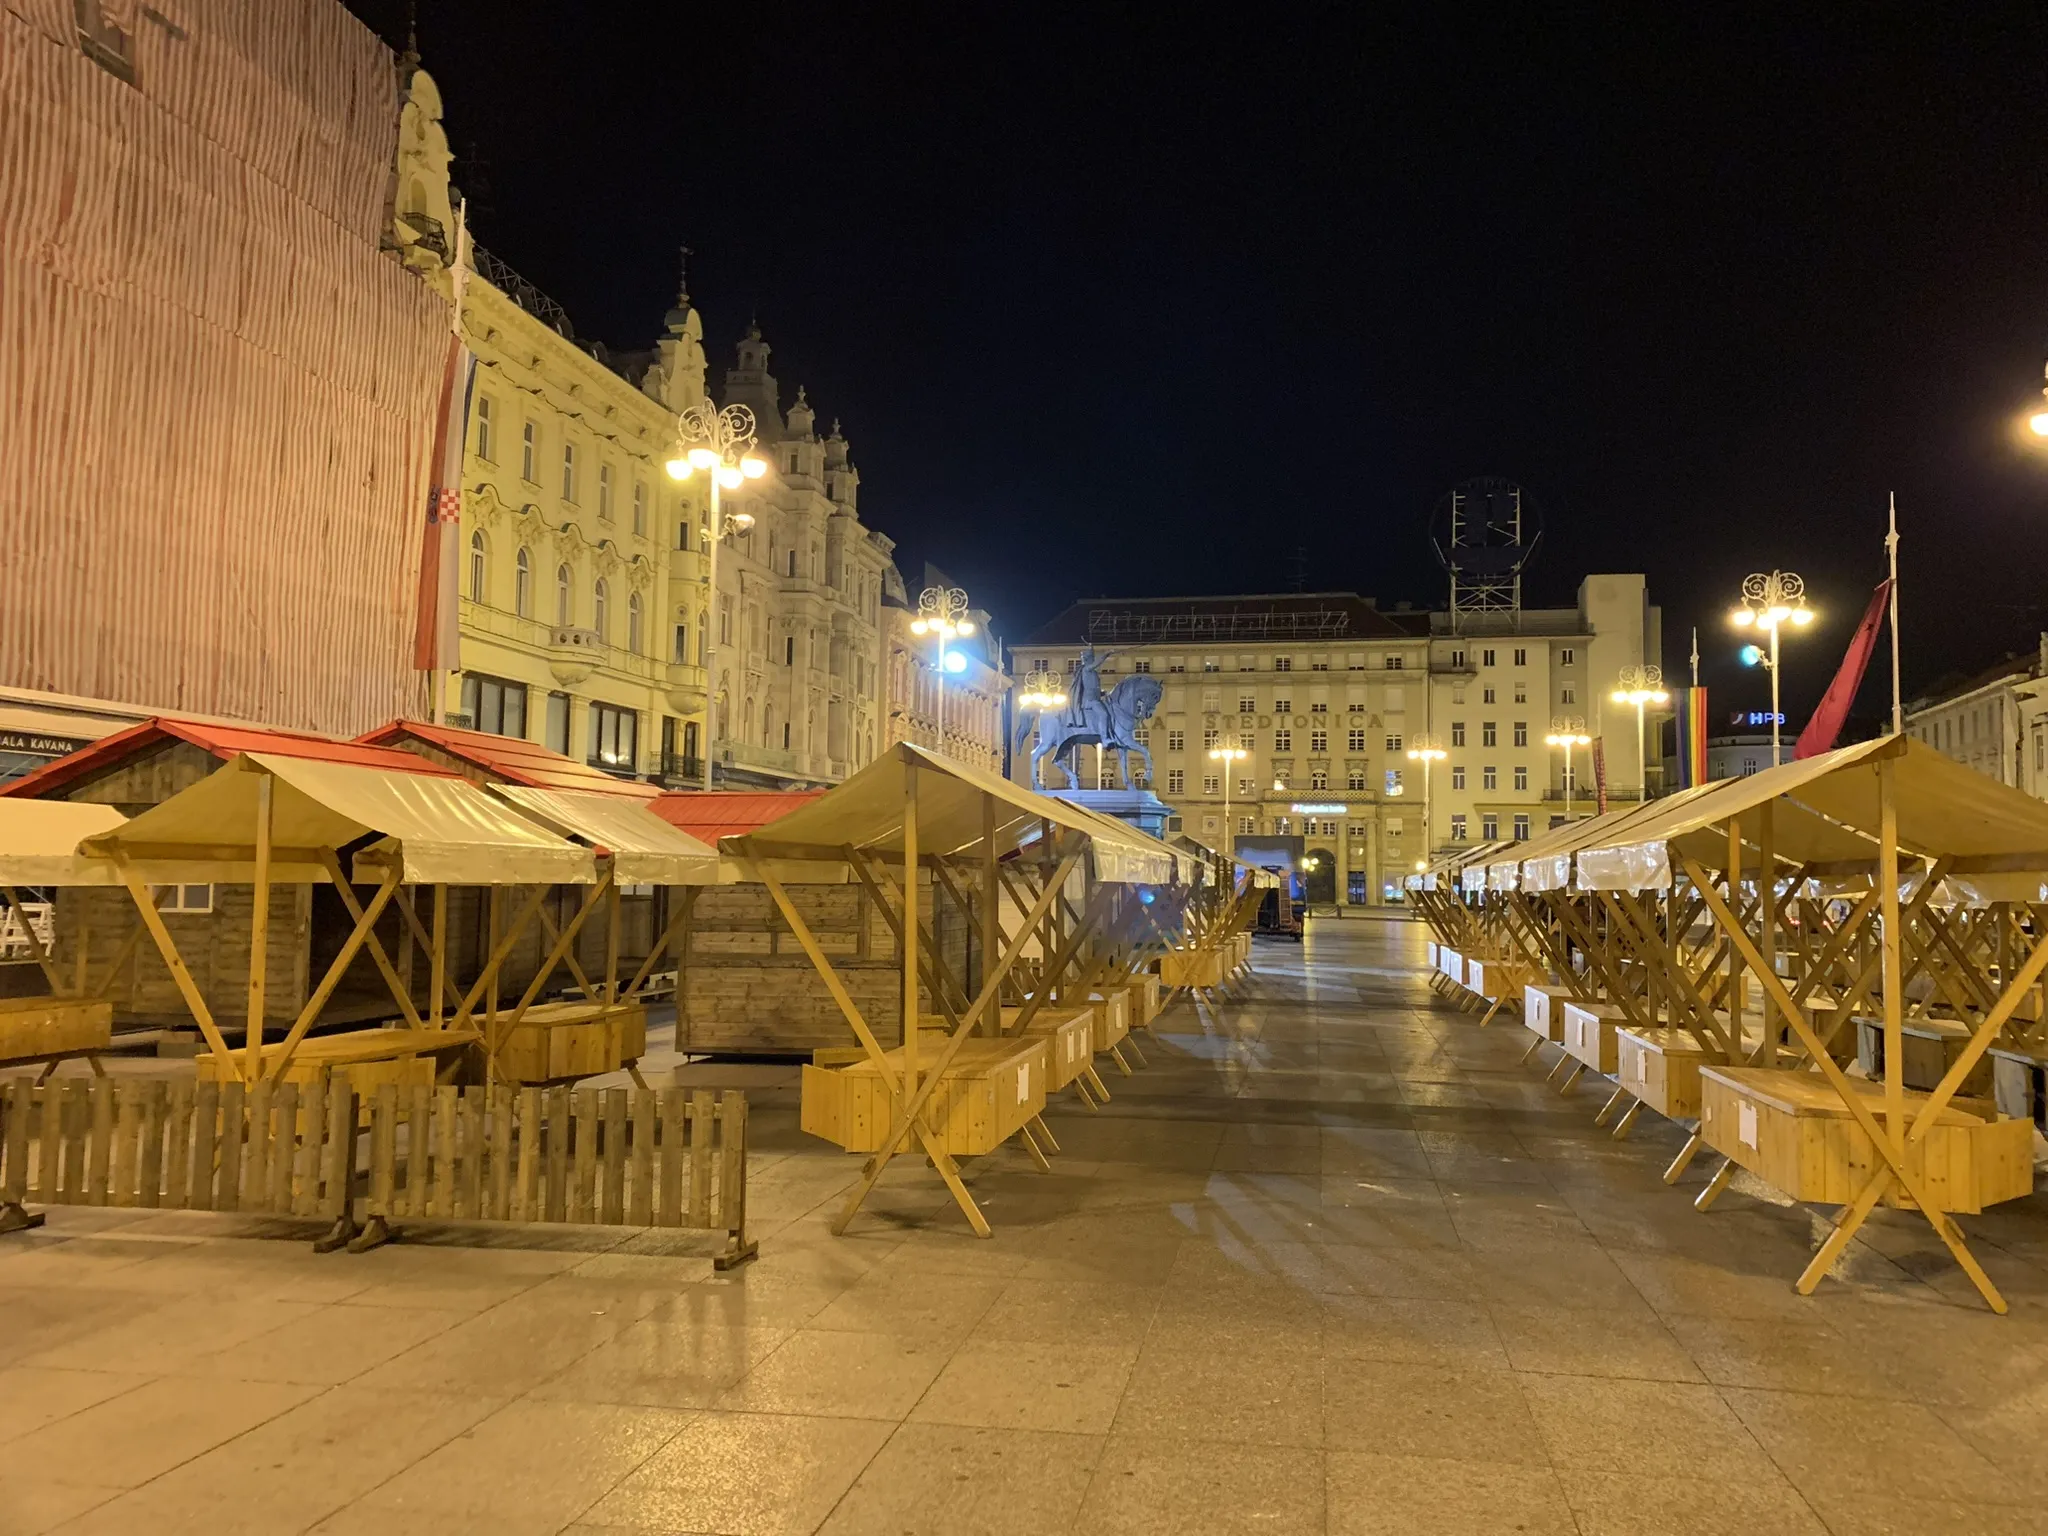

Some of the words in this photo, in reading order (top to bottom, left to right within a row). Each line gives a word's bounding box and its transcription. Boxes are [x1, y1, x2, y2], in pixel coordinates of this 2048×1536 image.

[1749, 712, 1785, 724] HPB
[0, 735, 24, 748] ALA
[30, 738, 72, 752] KAVANA
